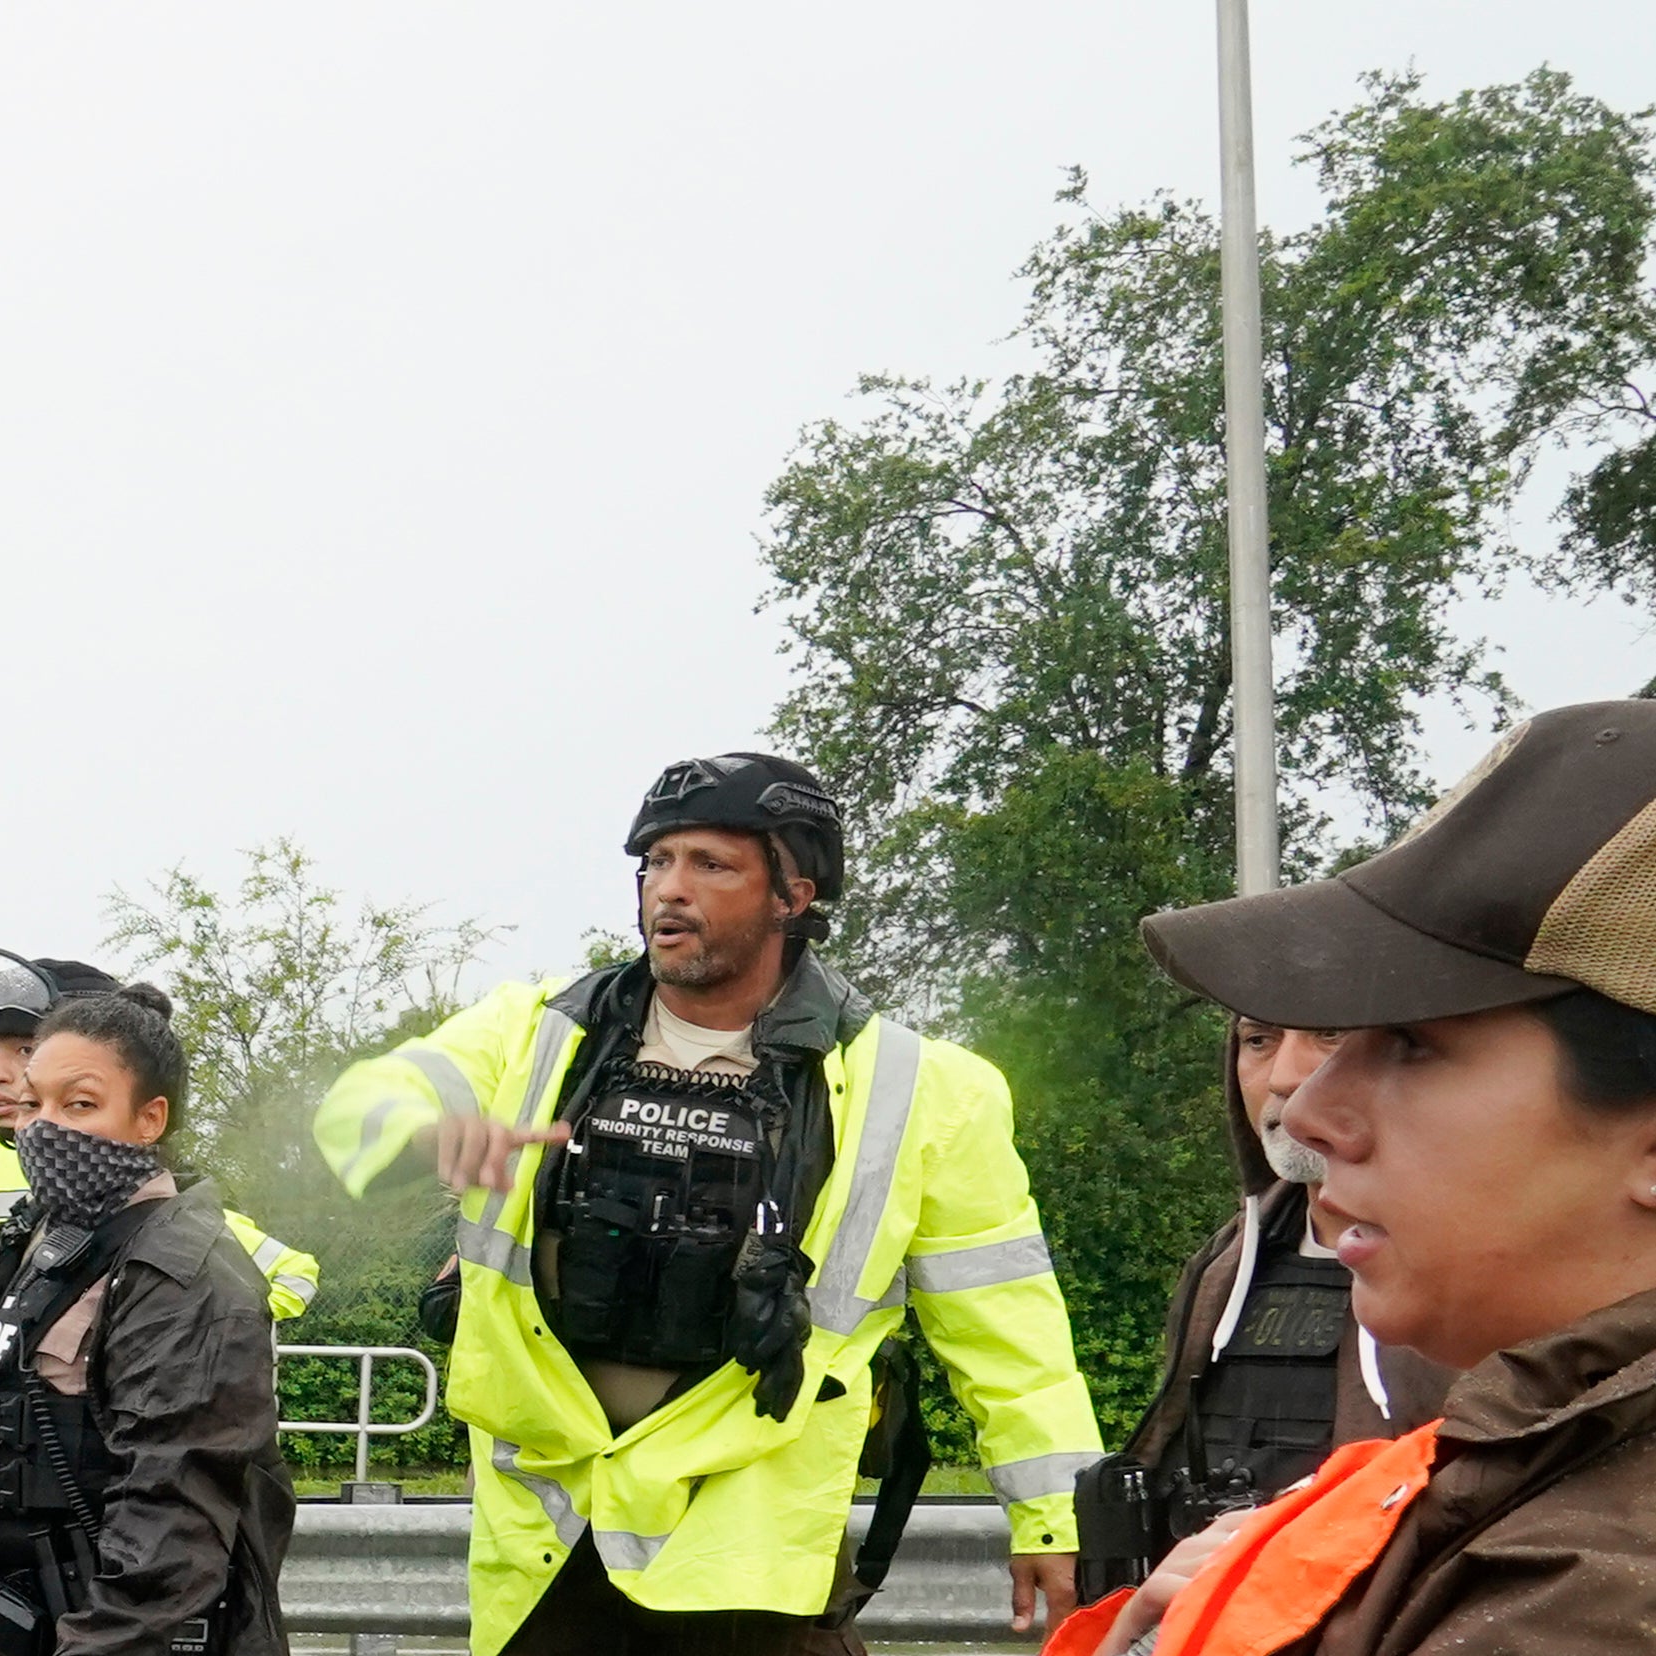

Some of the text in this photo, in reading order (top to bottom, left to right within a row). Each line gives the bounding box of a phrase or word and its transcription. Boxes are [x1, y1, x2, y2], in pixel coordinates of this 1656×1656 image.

[619, 1098, 730, 1134] POLICE
[592, 1117, 755, 1154] PRIORITY RESPONSE
[642, 1139, 688, 1159] TEAM
